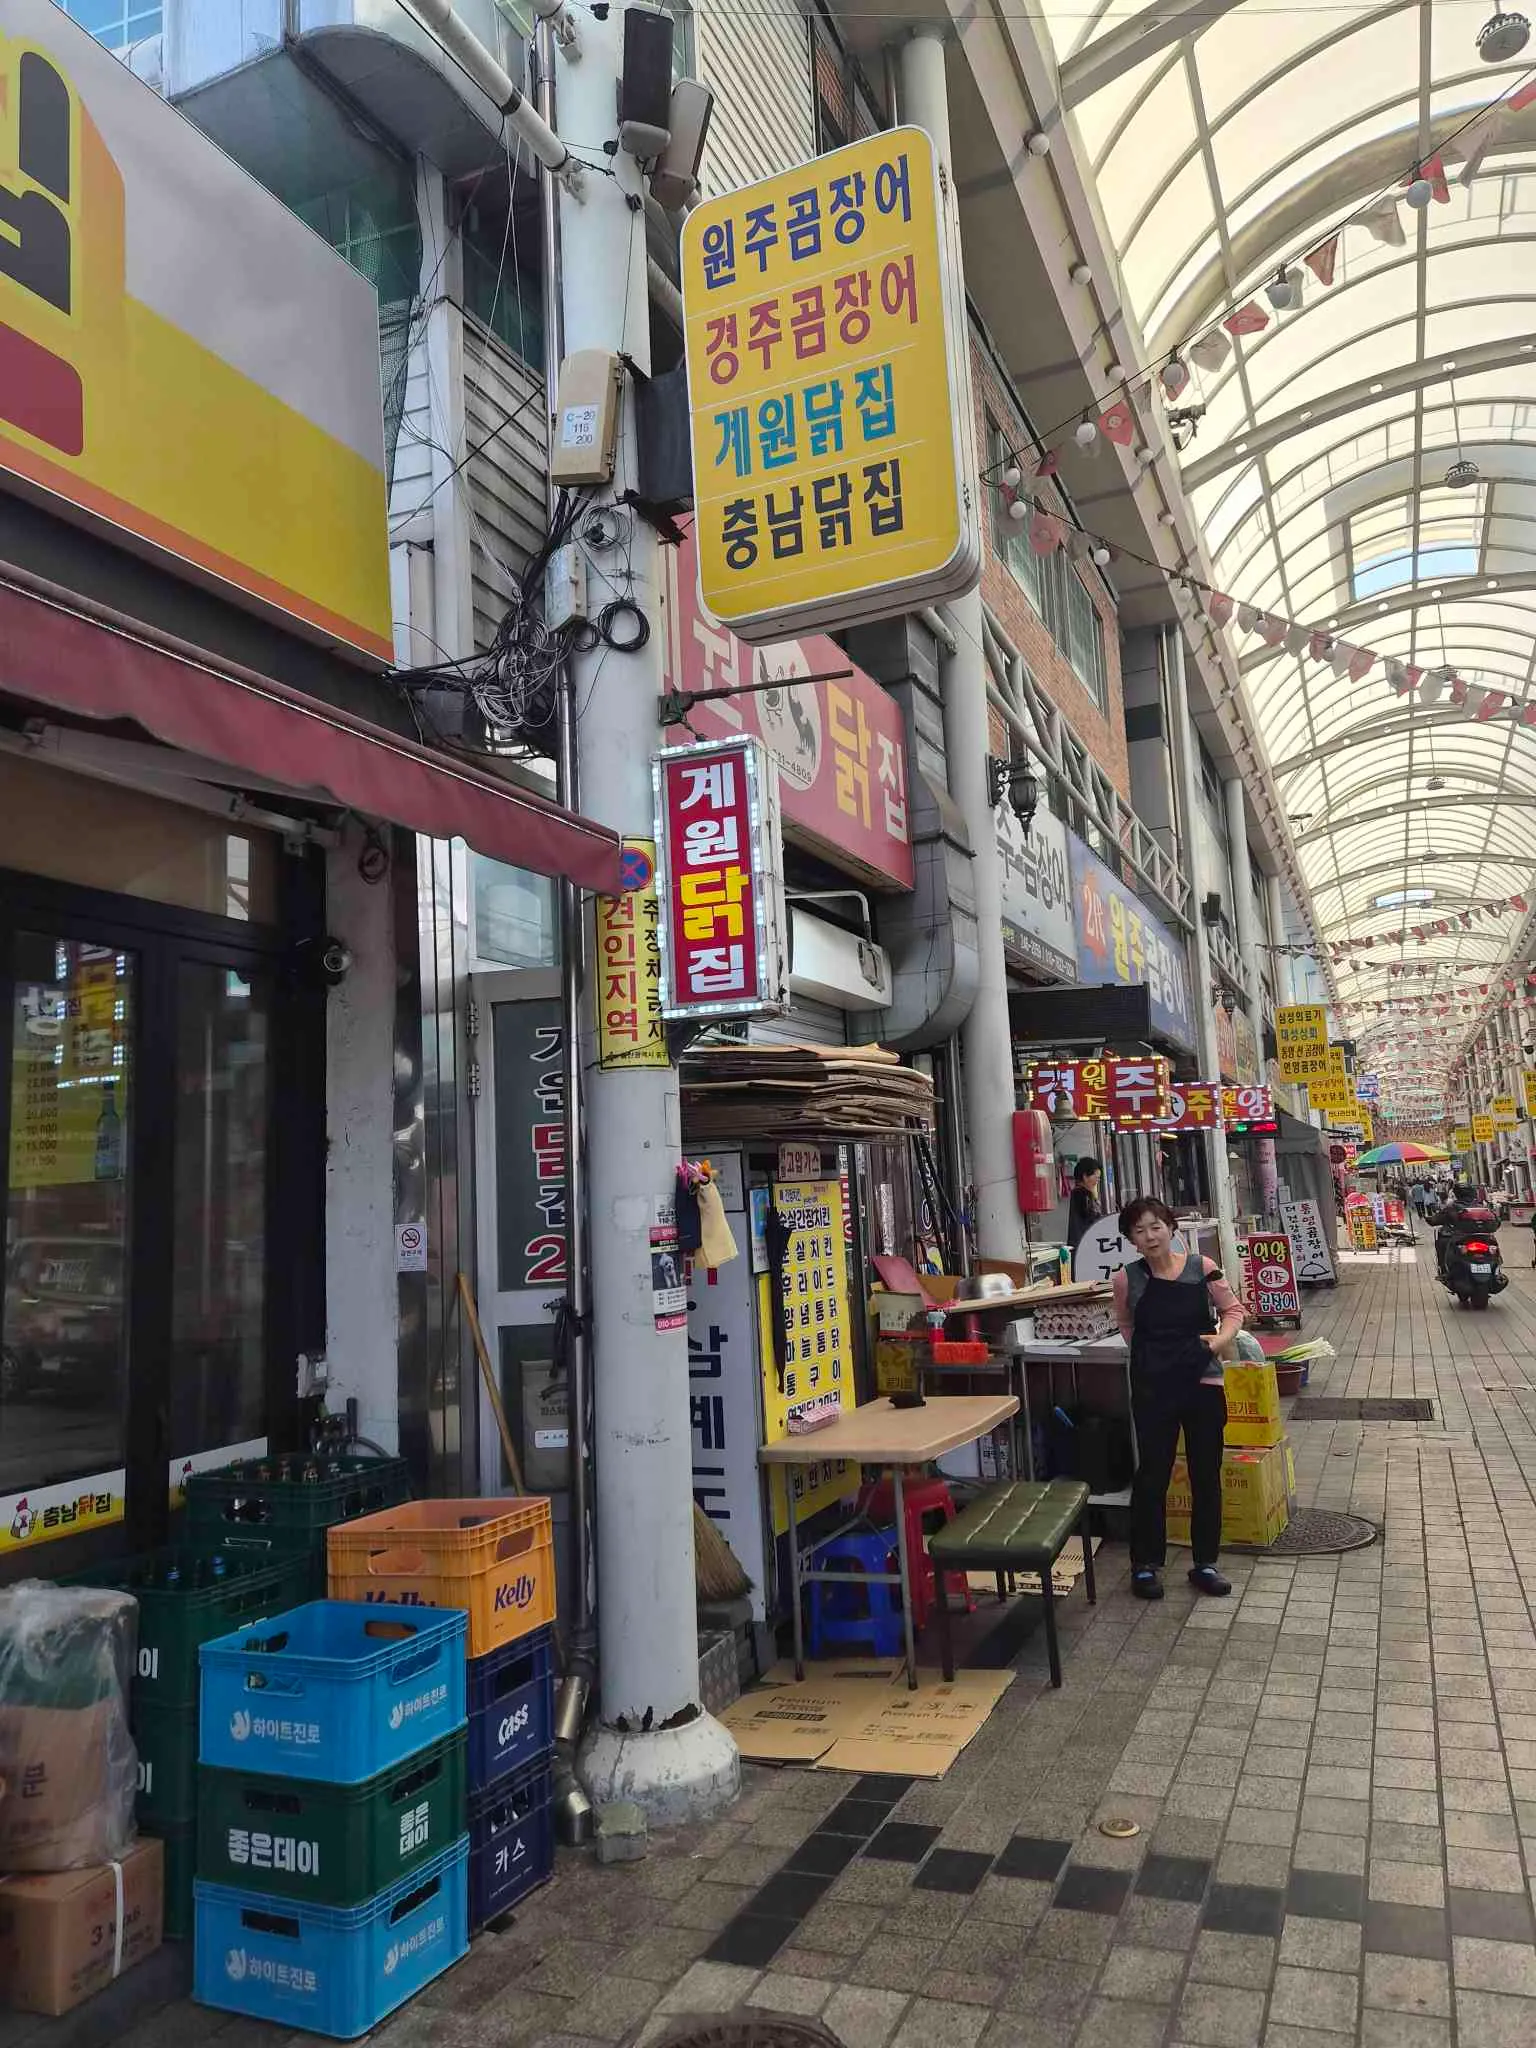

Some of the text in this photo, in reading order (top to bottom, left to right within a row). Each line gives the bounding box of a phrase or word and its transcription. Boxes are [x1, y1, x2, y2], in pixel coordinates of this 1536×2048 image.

[702, 154, 912, 291] 원주곰장어
[705, 255, 918, 386] 경주곰장어
[714, 362, 896, 478] 계원닭집
[722, 458, 904, 571] 충남닭집
[679, 761, 750, 995] 계원닭집
[593, 897, 638, 1042] 견인지역
[1253, 1240, 1288, 1263] 언양
[785, 1359, 840, 1397] 통구이
[43, 1492, 111, 1529] 충남닭집
[494, 1575, 537, 1613] Kelly
[404, 1683, 447, 1728] 하이트진로
[498, 1704, 529, 1746] Cass
[253, 1718, 320, 1744] 하이트진로
[400, 1801, 429, 1833] 좋은
[228, 1828, 320, 1877] 좋은데이
[400, 1825, 429, 1853] 데이
[495, 1838, 526, 1875] 카스
[249, 1961, 317, 1991] 하이트진로
